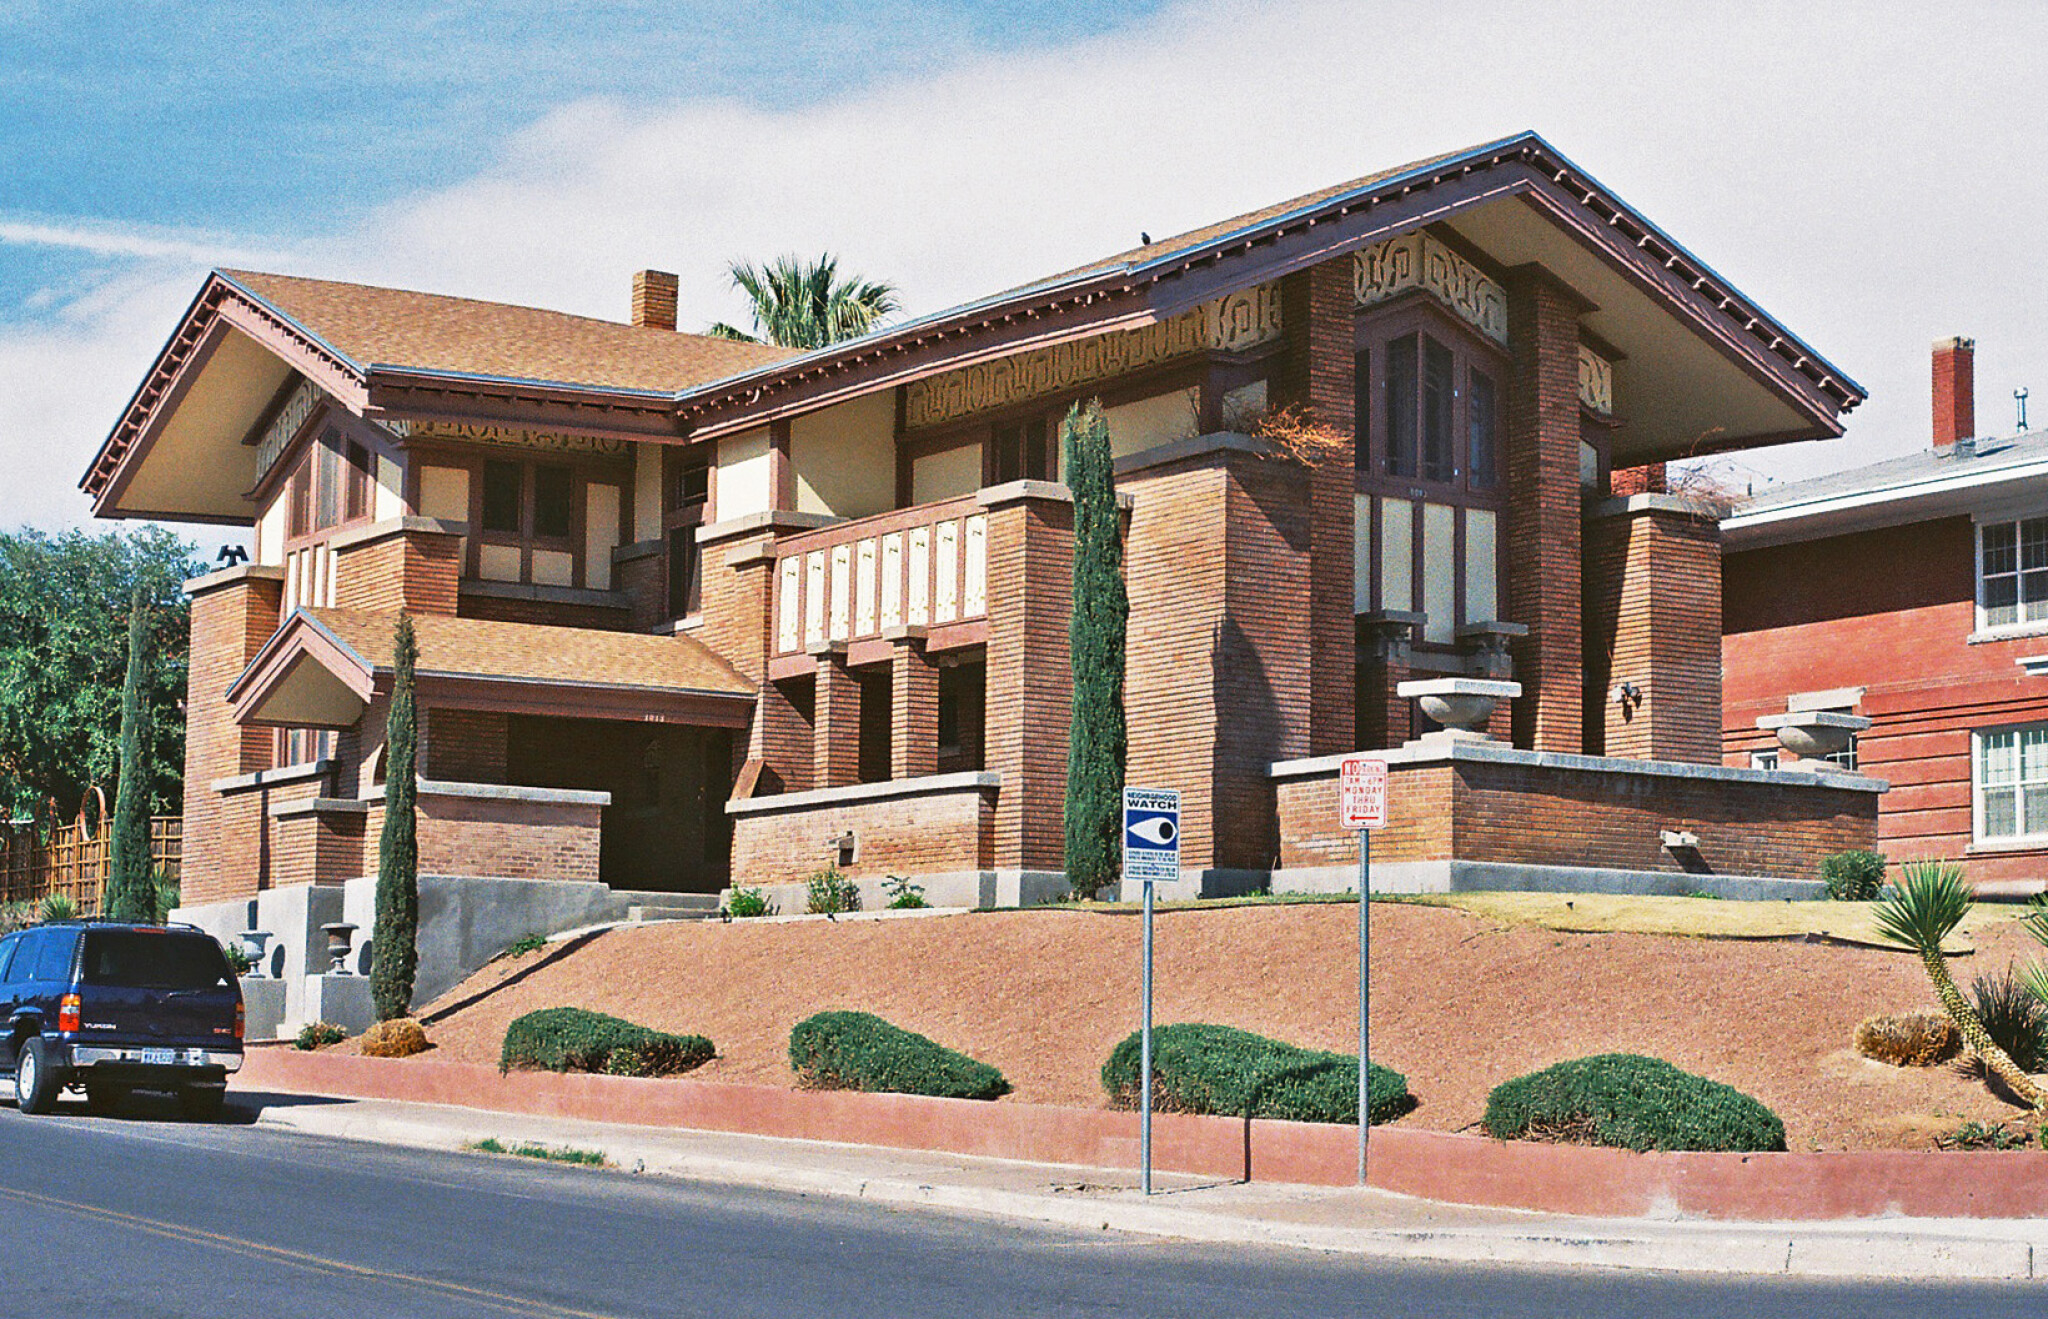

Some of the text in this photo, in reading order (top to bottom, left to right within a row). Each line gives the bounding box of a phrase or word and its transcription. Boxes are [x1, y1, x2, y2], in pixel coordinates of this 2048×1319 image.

[1344, 762, 1360, 775] NO
[1345, 786, 1382, 794] MONDAY
[1127, 792, 1177, 801] NEIGHBORHOOD
[1127, 799, 1177, 810] WATCH
[1346, 805, 1380, 813] FRIDAY
[83, 1022, 117, 1030] YUKON
